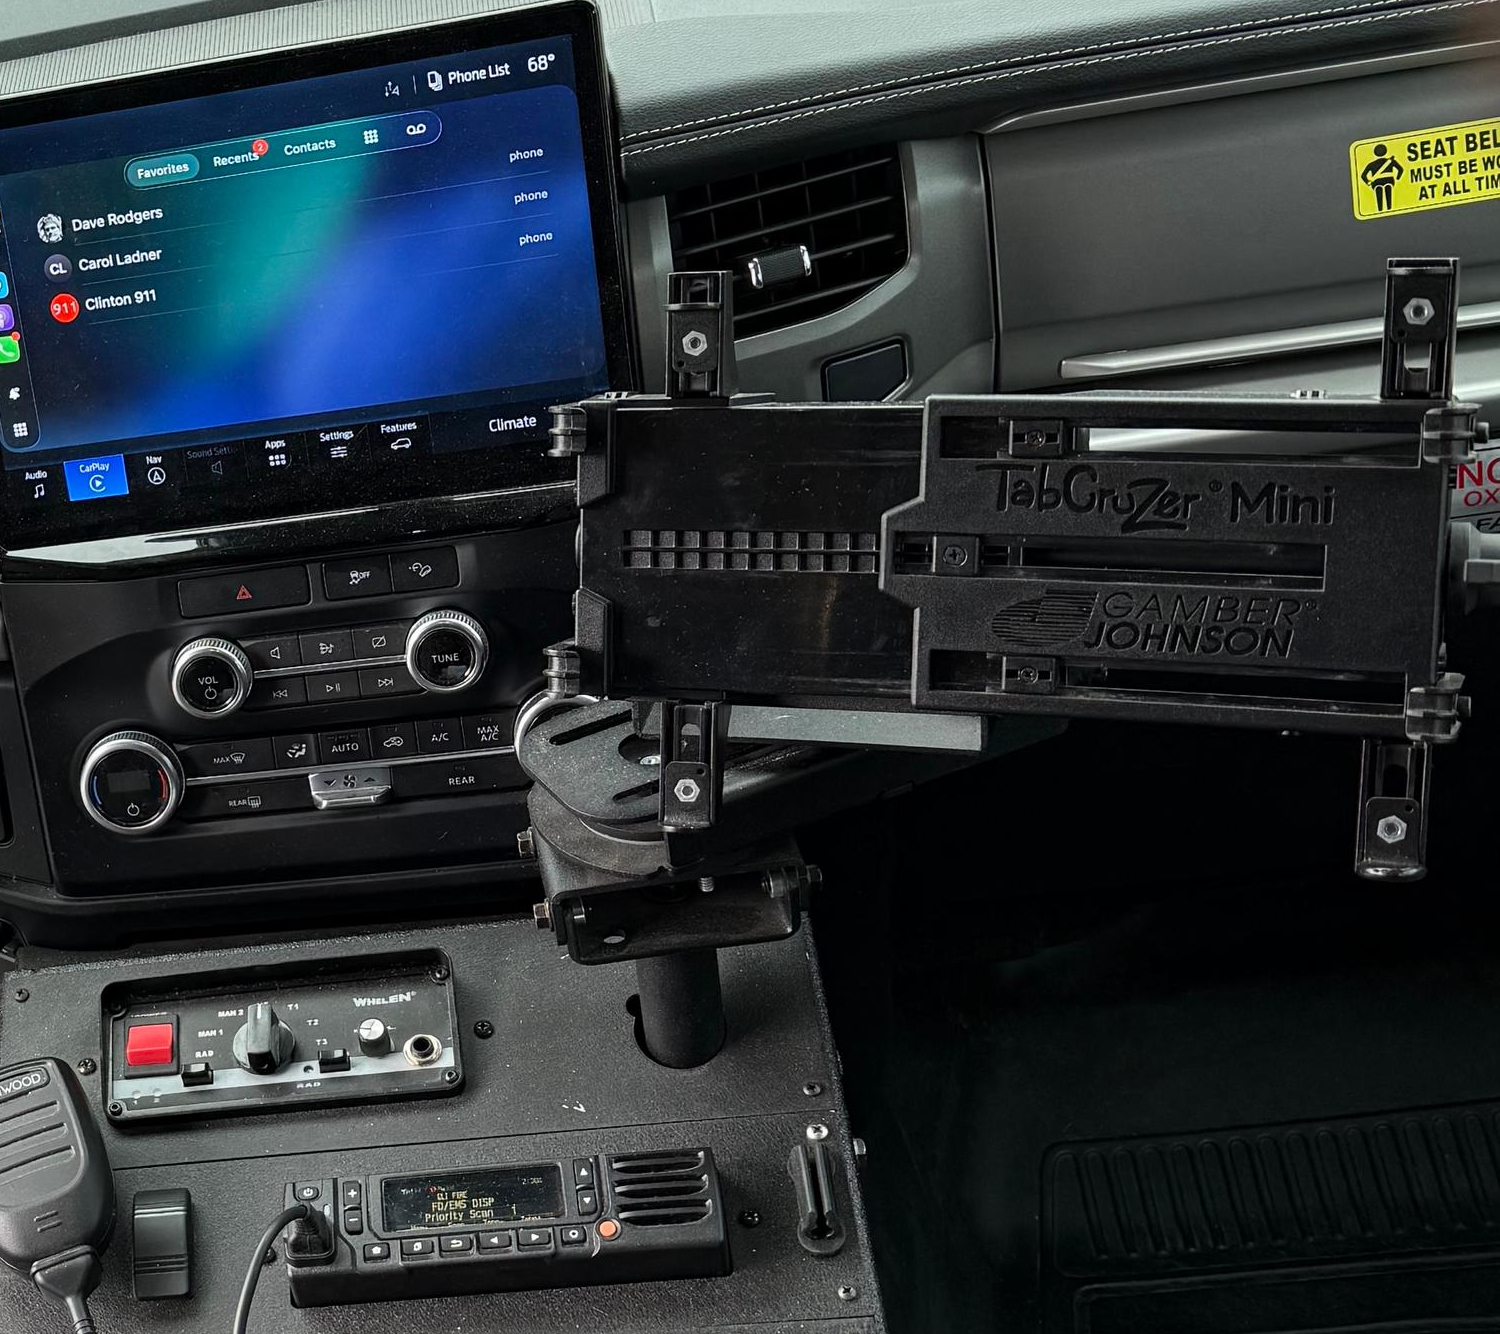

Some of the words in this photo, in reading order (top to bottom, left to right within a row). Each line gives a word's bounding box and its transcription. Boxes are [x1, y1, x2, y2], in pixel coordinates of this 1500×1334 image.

[527, 53, 556, 73] 68°
[447, 66, 487, 87] Phone
[488, 62, 511, 78] List
[284, 137, 336, 156] Contacts
[1407, 136, 1458, 162] SEAT
[1465, 128, 1500, 153] BEL
[213, 149, 260, 167] Recents
[509, 146, 544, 163] phone
[137, 162, 190, 180] Favorites
[1410, 163, 1453, 183] MUST
[1458, 159, 1478, 175] BE
[514, 189, 548, 205] phone
[1419, 184, 1437, 201] AT
[1443, 179, 1471, 197] ALL
[71, 216, 105, 232] Dave
[106, 207, 164, 228] Rodgers
[518, 231, 553, 247] phone
[78, 254, 114, 271] Carol
[115, 247, 162, 267] Ladner
[49, 262, 68, 276] CL
[85, 291, 132, 311] Clinton
[133, 289, 157, 304] 911
[52, 300, 78, 315] 911
[380, 421, 417, 434] Features
[488, 415, 537, 433] Climate
[319, 429, 354, 443] Settings
[265, 438, 287, 450] Apps
[146, 454, 163, 465] Nav
[186, 447, 214, 460] Sound
[79, 461, 110, 474] CarPlay
[25, 469, 48, 481] Audio
[975, 464, 1202, 535] TabCruZer
[1229, 480, 1336, 525] Mini
[357, 570, 371, 580] OFF
[1103, 591, 1302, 626] GAMBER
[1083, 621, 1295, 659] JOHNSON
[431, 652, 459, 663] TUNE
[198, 677, 218, 685] VOL
[477, 725, 500, 735] MAX
[431, 732, 450, 743] A/C
[480, 732, 499, 743] A/C
[331, 742, 359, 753] AUTO
[213, 756, 231, 765] MAX
[448, 775, 475, 786] REAR
[228, 798, 248, 807] REAR
[353, 991, 412, 1008] WHELEN
[218, 1009, 237, 1017] MAN
[287, 1003, 299, 1011] T1
[198, 1030, 217, 1038] MAN
[316, 1038, 328, 1046] T3
[195, 1050, 214, 1058] RAD
[432, 1199, 467, 1212] FD/EMS
[472, 1197, 495, 1208] DISP
[425, 1211, 464, 1223] Priority
[470, 1209, 494, 1219] Scan
